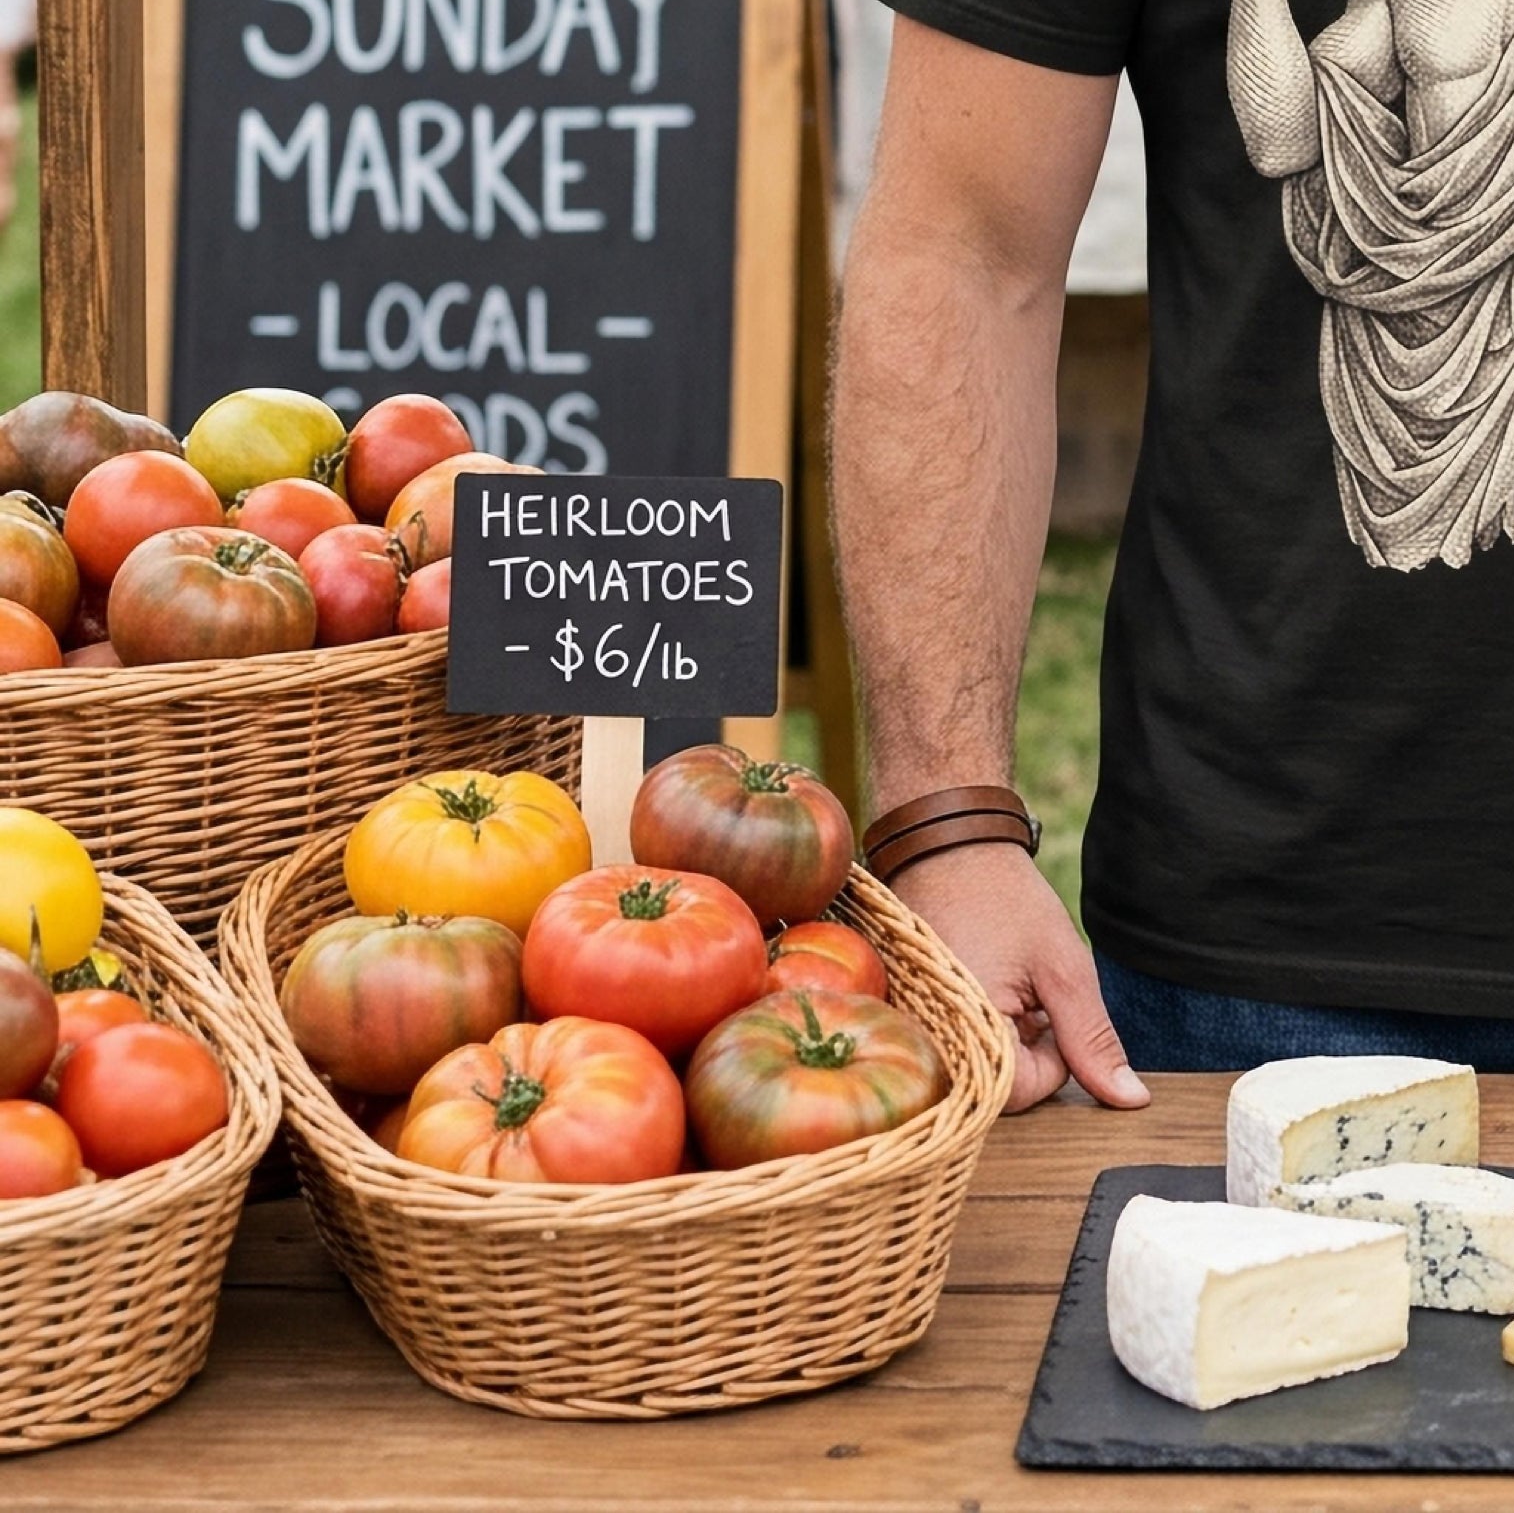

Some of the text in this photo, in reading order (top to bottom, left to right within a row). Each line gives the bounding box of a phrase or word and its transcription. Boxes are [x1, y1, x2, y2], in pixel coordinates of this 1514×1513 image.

[234, 98, 696, 242] MARKET
[316, 280, 591, 376] LOCAL
[480, 489, 732, 543] HEIRLOOM
[487, 555, 754, 607] TOMATOES
[549, 617, 700, 689] $6/lb
